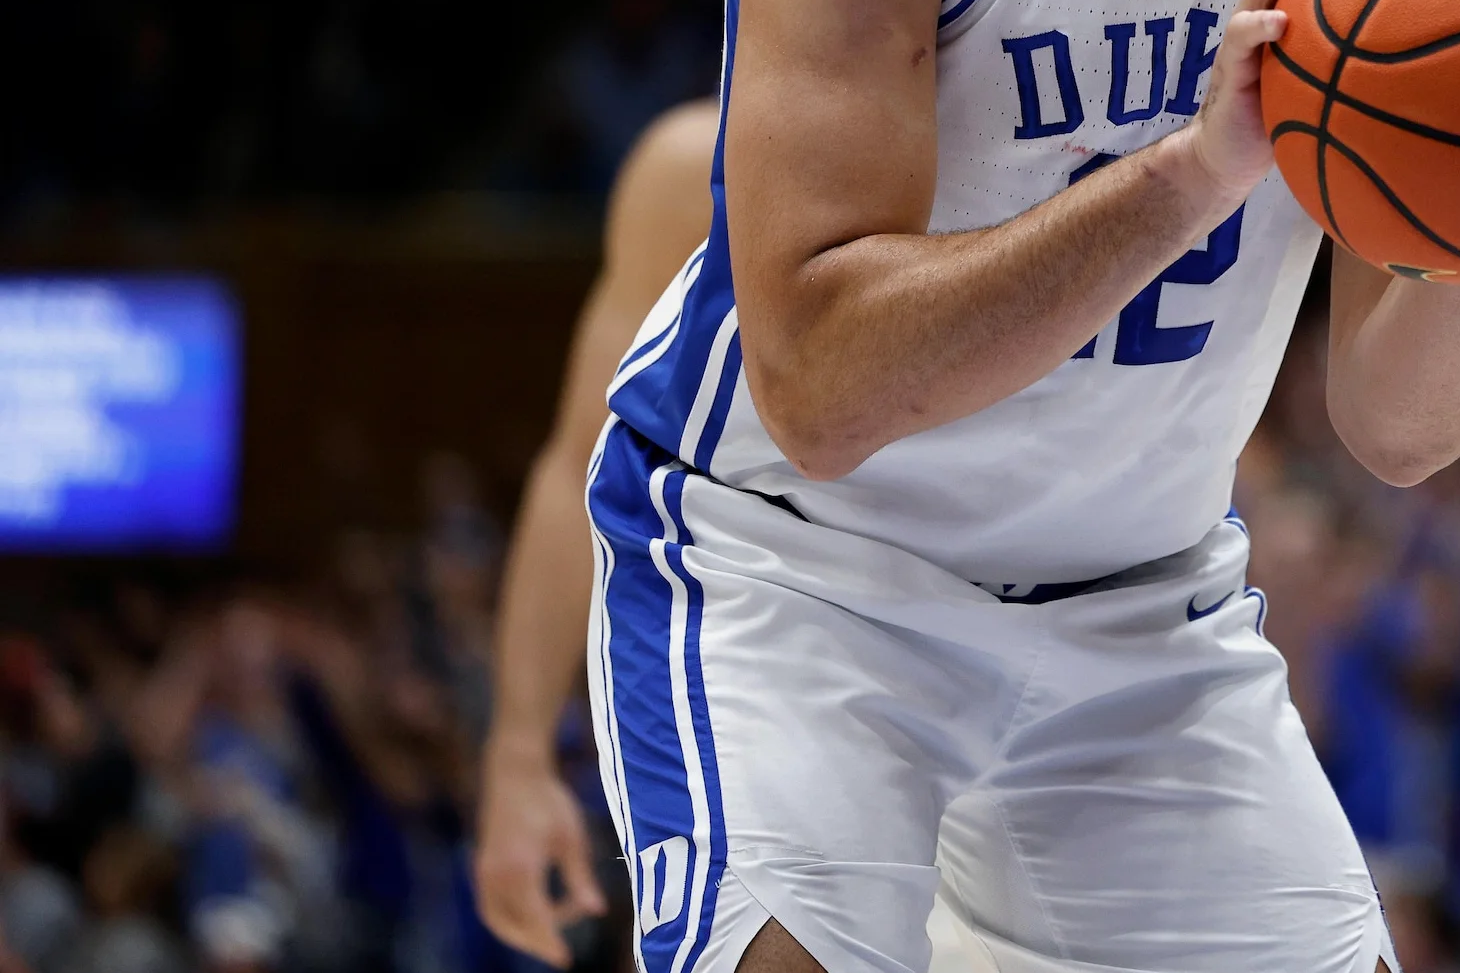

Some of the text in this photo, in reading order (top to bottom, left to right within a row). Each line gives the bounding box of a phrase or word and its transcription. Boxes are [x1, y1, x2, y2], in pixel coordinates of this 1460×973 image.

[1002, 7, 1221, 140] DUK
[1068, 152, 1247, 366] 2
[638, 835, 689, 937] D
